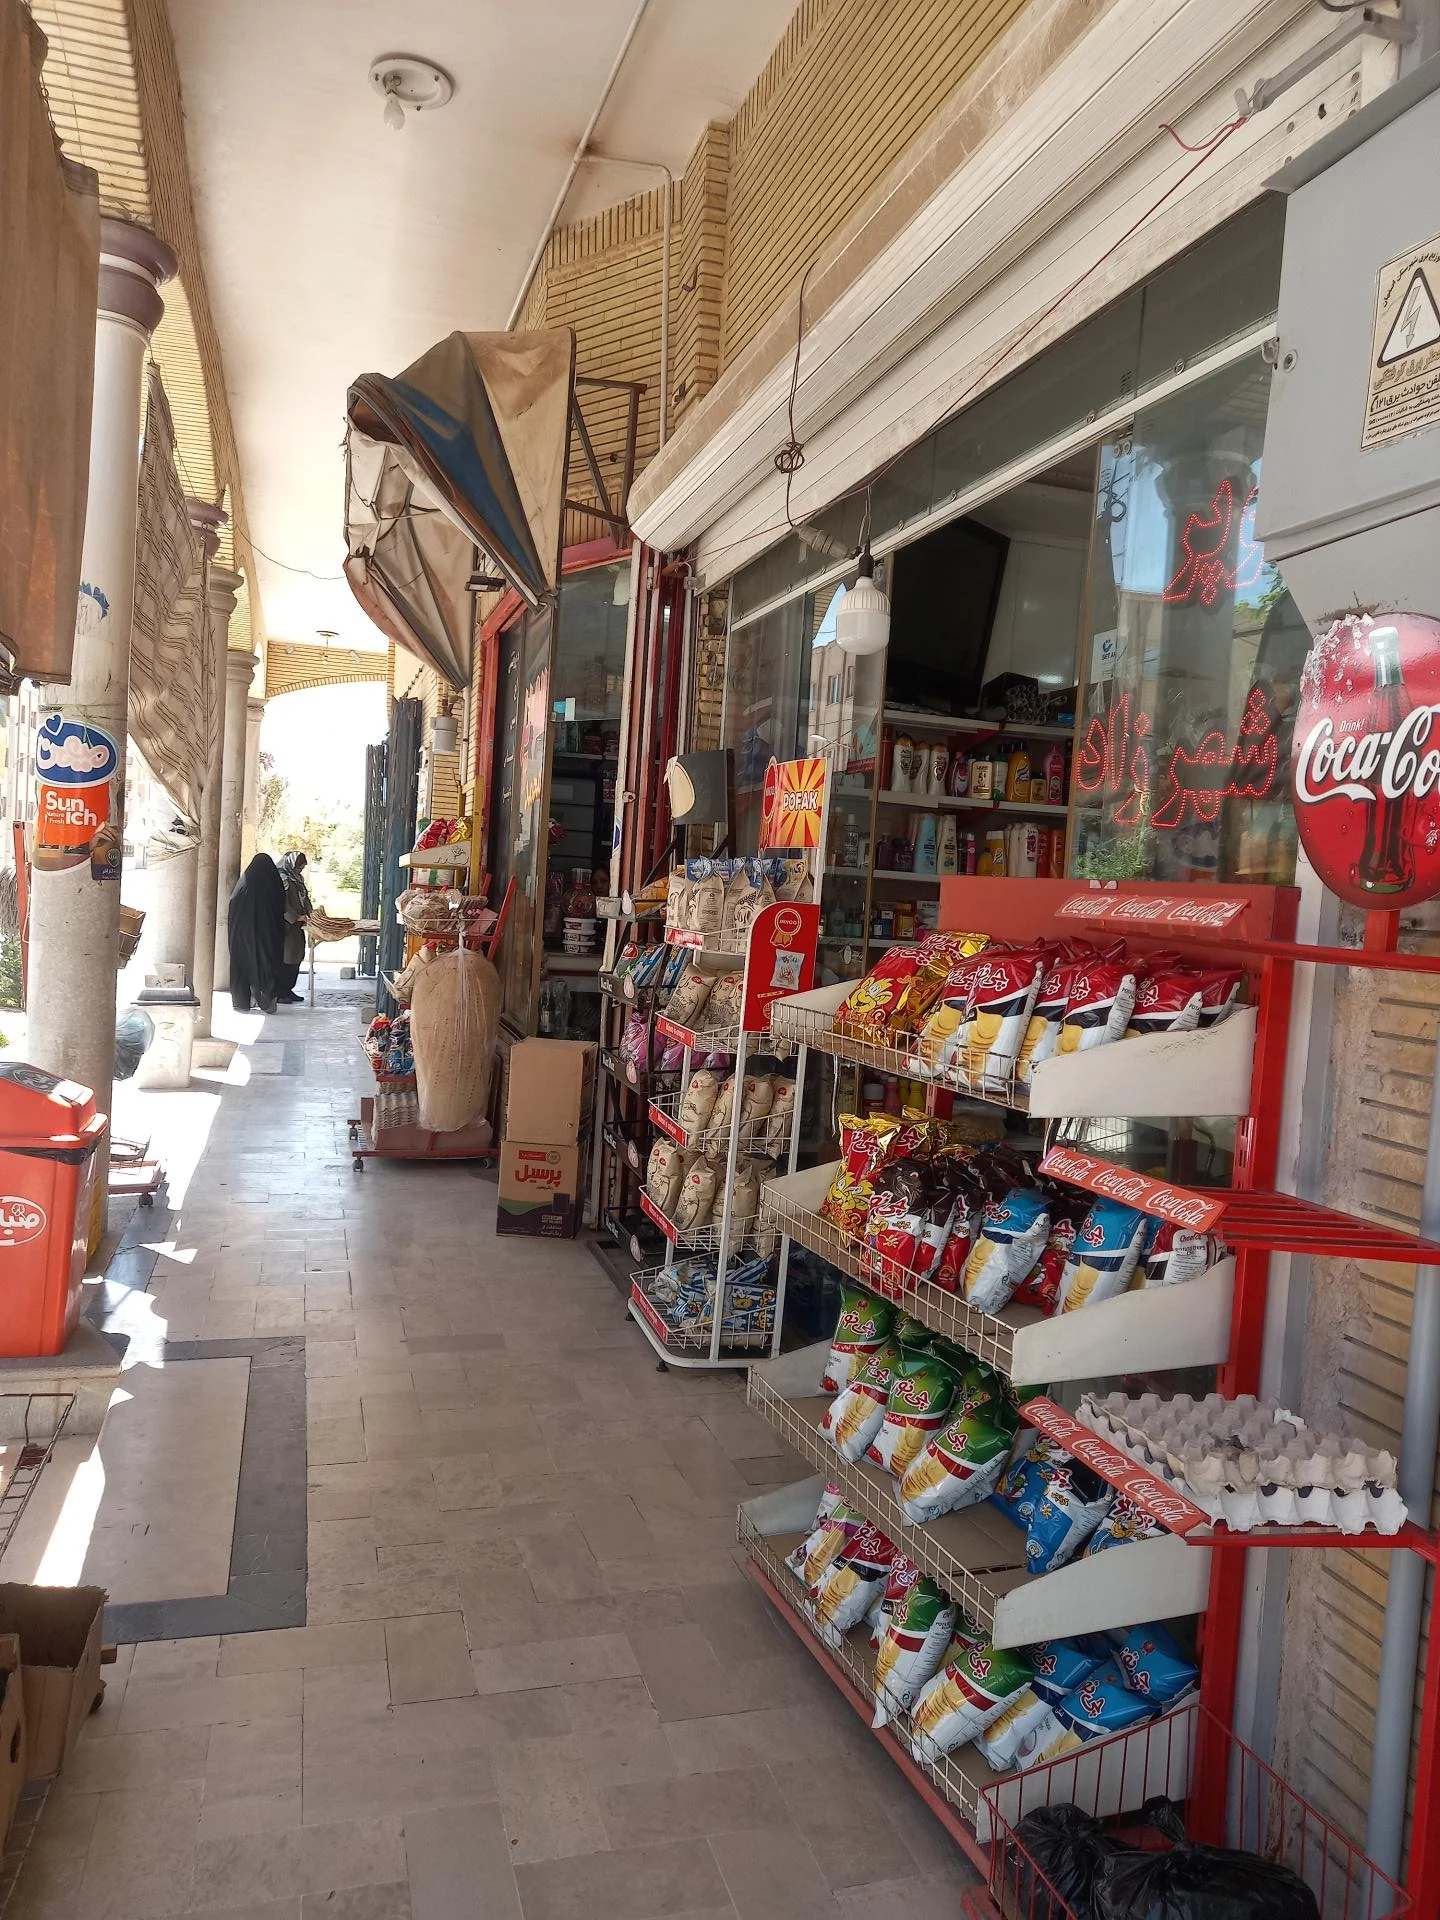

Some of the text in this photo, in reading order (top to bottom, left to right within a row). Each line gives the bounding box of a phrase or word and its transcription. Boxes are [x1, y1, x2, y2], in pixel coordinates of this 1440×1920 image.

[1401, 382, 1426, 398] حوادث
[1426, 372, 1440, 391] لفن
[1387, 393, 1401, 408] برق
[1340, 719, 1366, 733] Drink!
[1295, 704, 1440, 804] Coca-Co
[45, 790, 85, 812] Sun
[783, 790, 818, 812] POFAK
[514, 1164, 562, 1188] پرسیل
